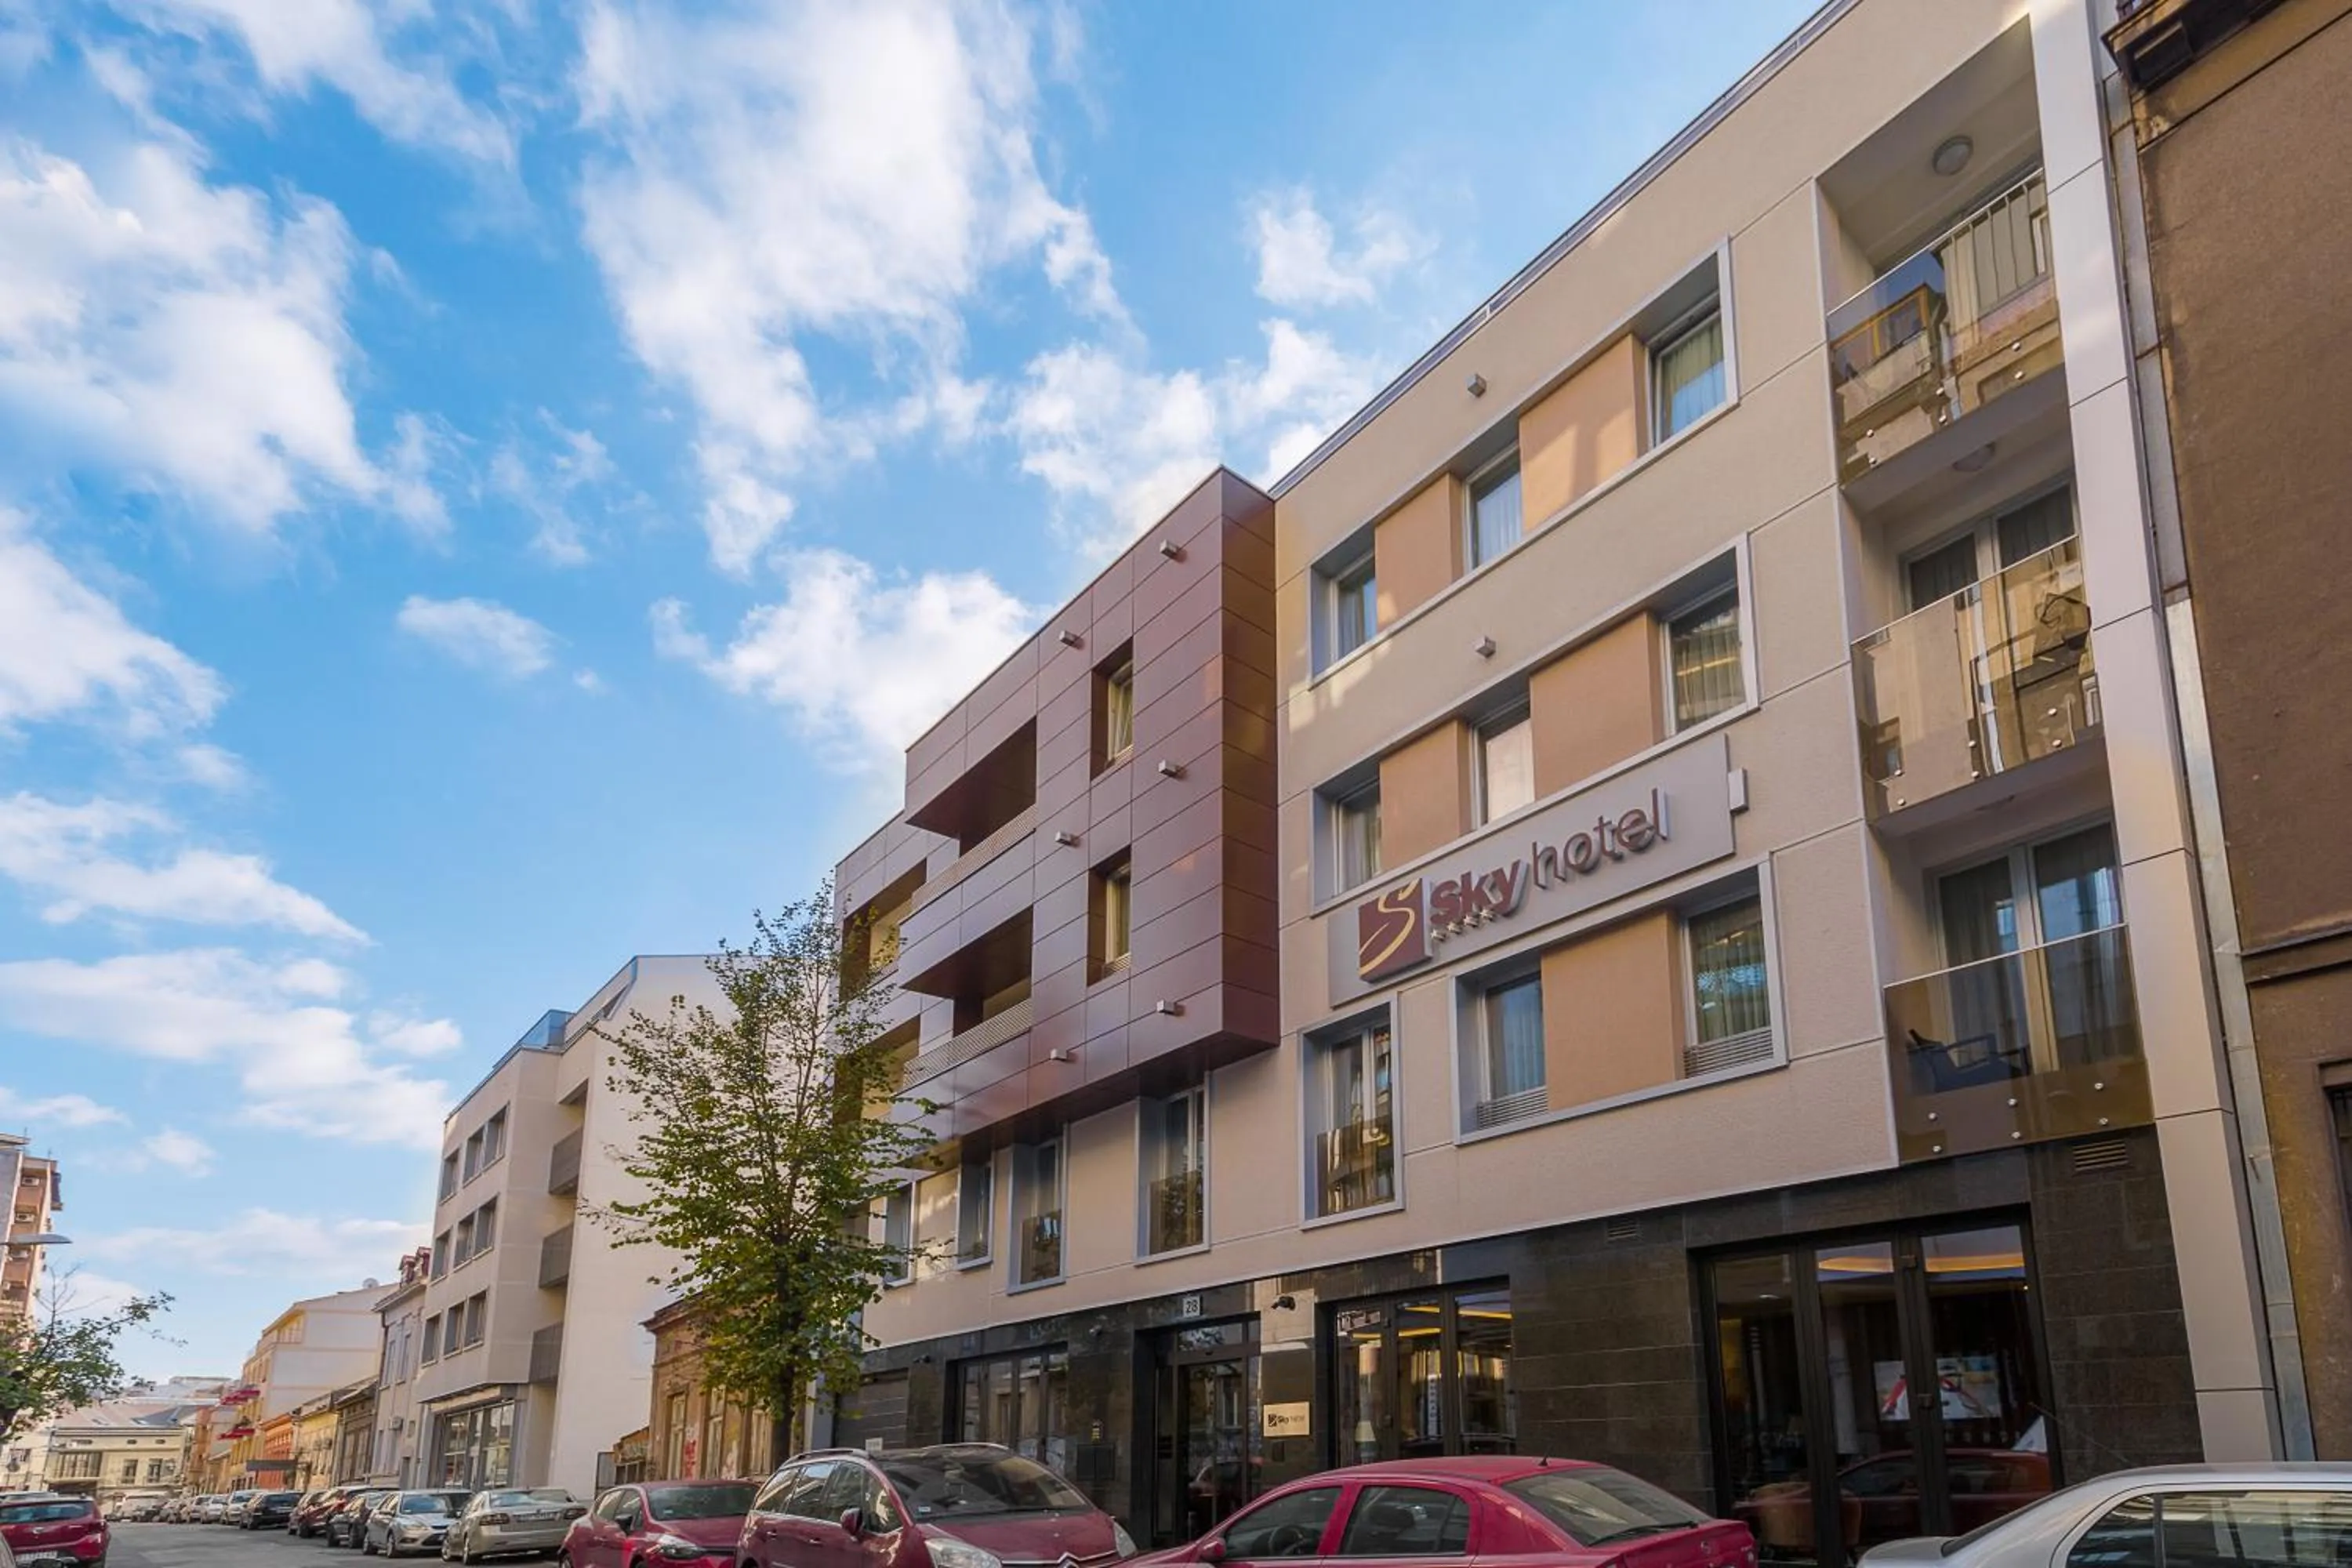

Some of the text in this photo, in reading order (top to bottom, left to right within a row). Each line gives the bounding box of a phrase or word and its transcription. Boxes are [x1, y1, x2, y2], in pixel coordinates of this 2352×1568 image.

[1430, 859, 1525, 925] sky
[1532, 787, 1668, 889] hotel
[1185, 1299, 1199, 1313] 28
